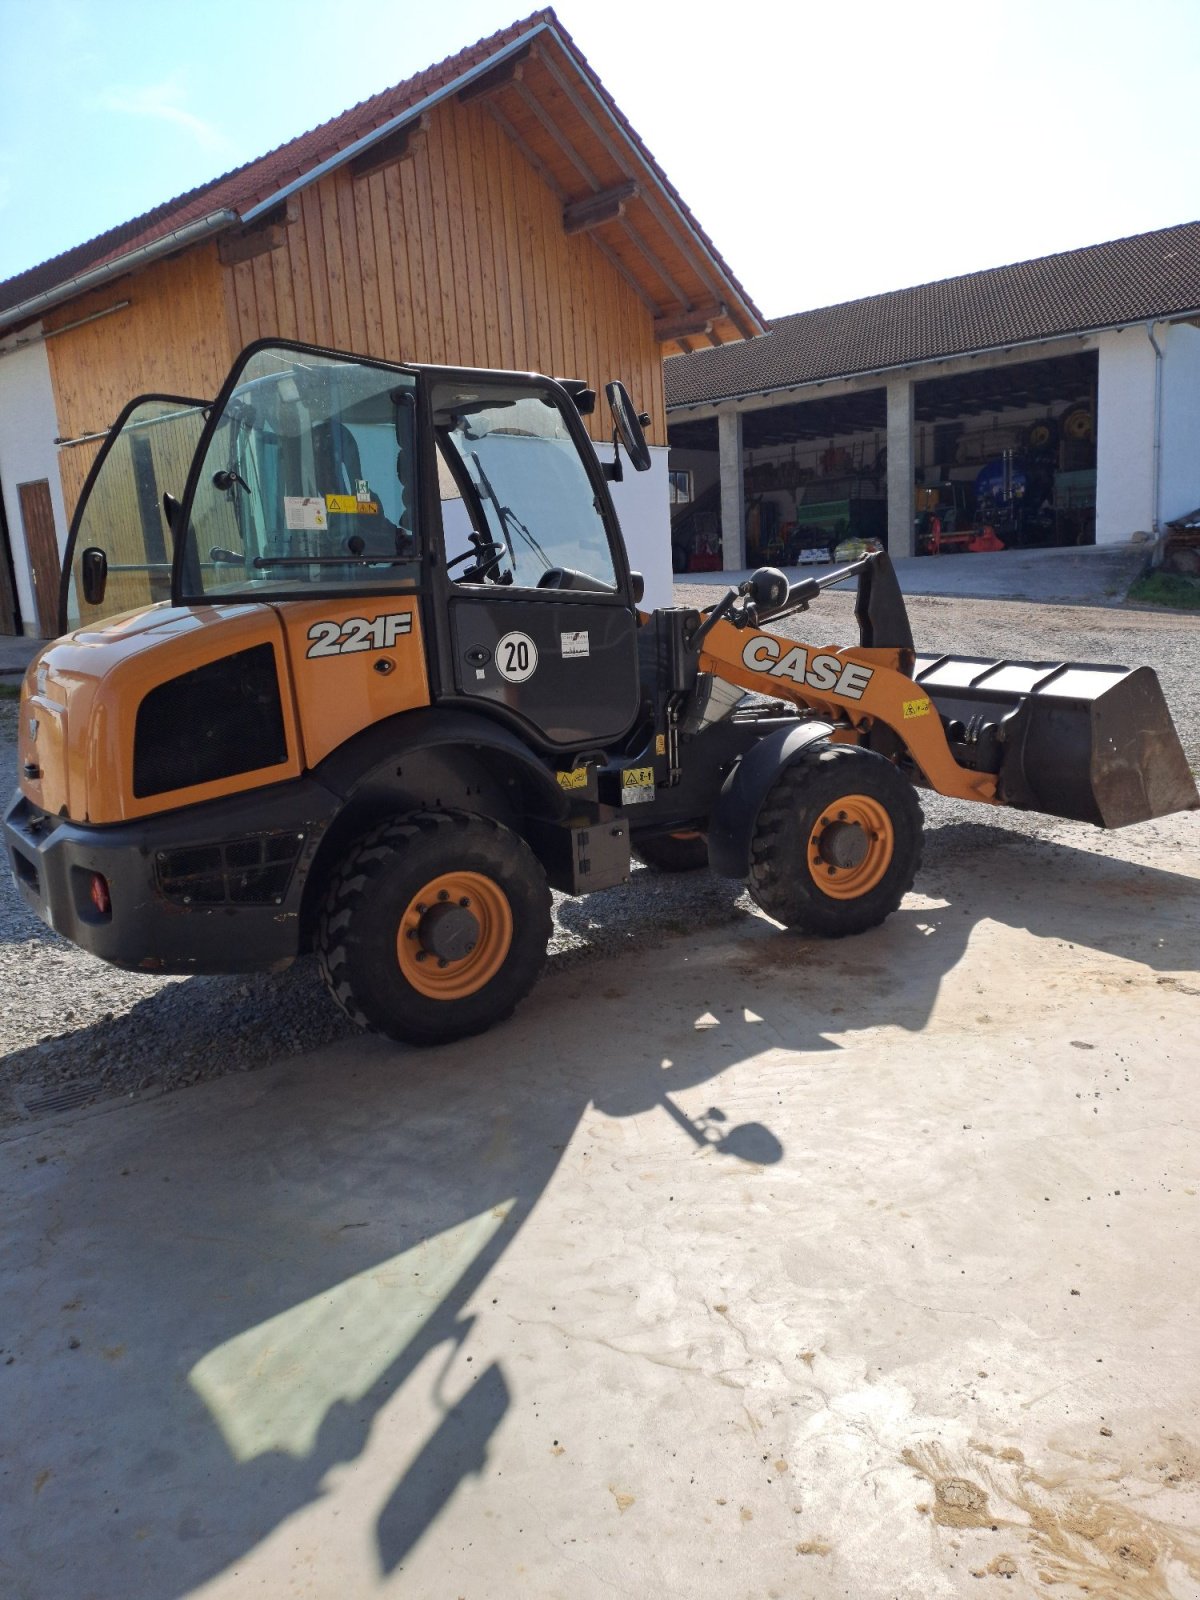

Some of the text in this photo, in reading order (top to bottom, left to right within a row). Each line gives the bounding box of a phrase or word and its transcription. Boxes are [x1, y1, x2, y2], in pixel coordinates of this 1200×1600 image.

[306, 612, 412, 659] 221F
[505, 641, 528, 672] 20
[742, 636, 875, 700] CASE
